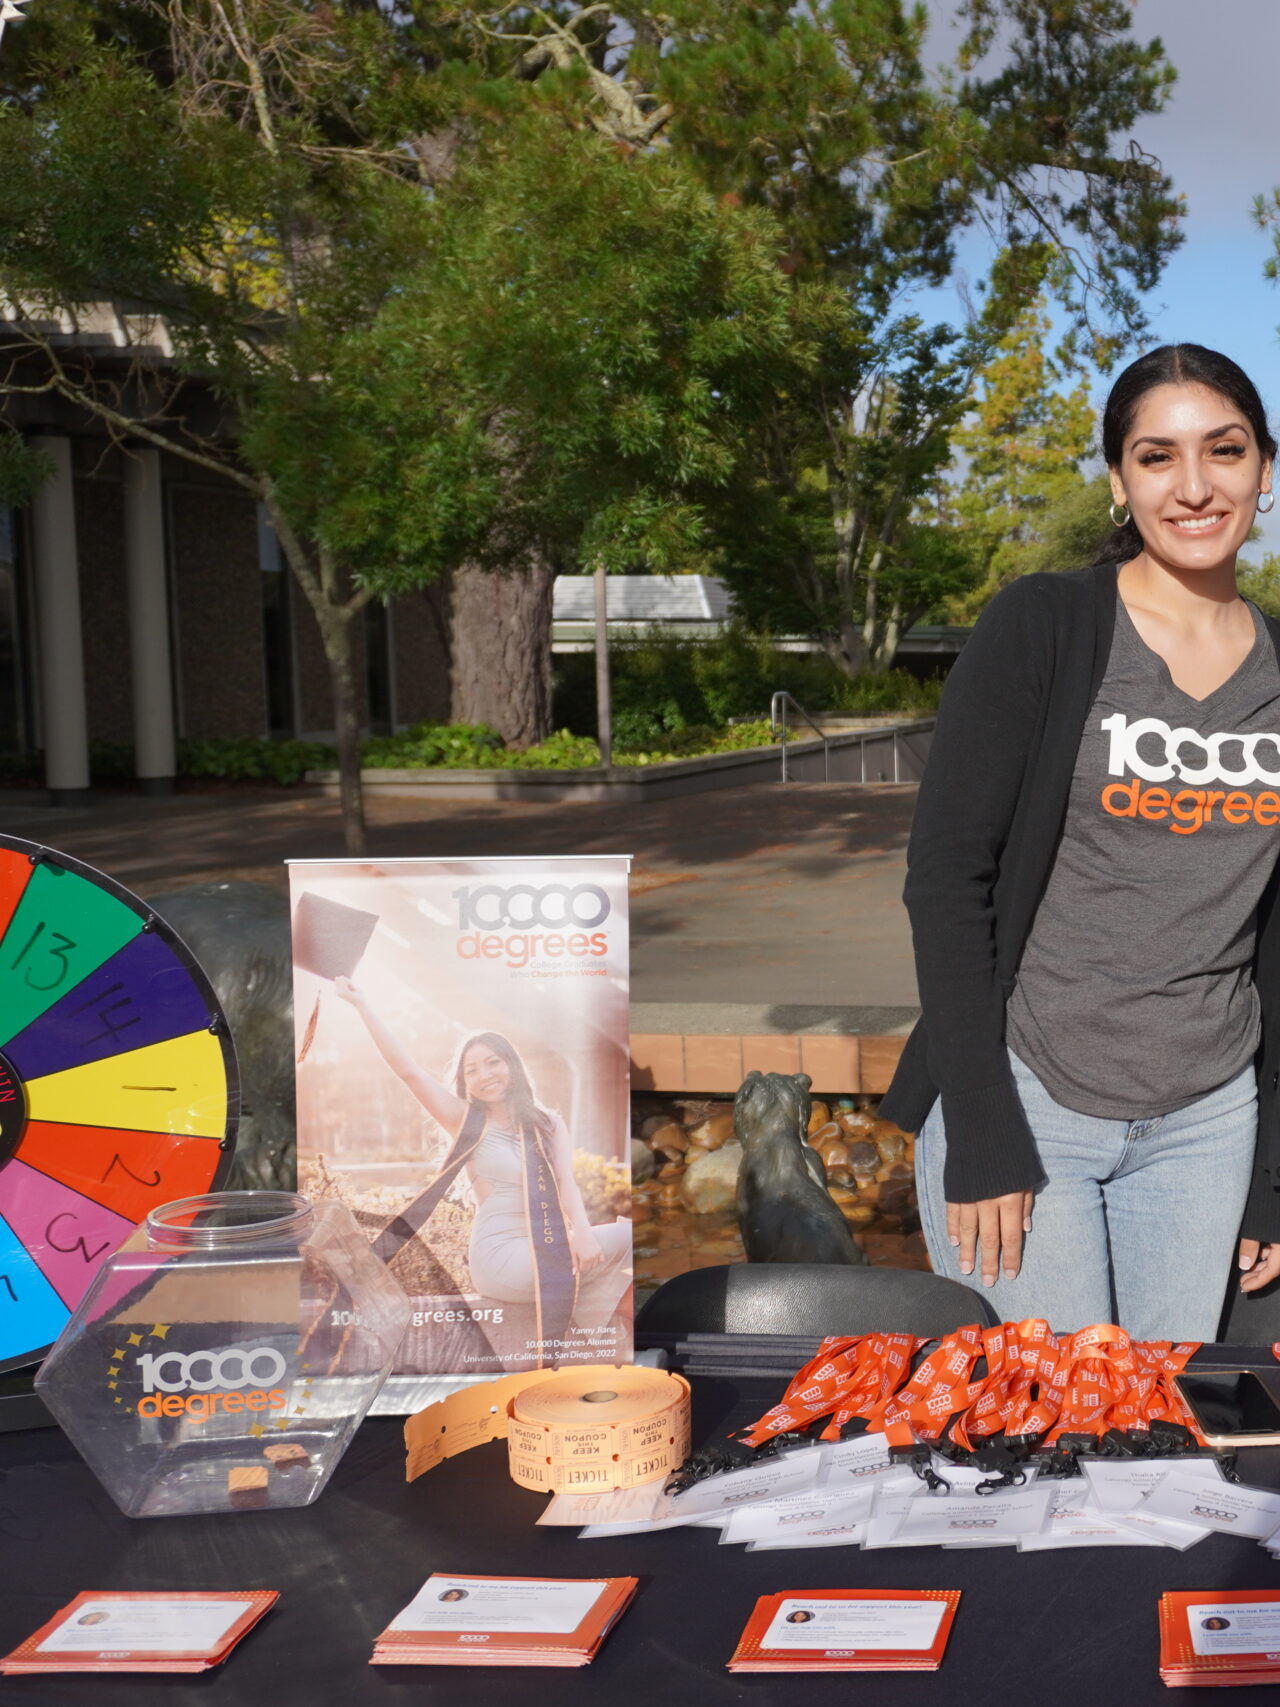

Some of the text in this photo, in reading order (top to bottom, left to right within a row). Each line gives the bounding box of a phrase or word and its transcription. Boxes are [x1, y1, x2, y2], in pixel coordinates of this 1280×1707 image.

[10, 921, 77, 991] 13
[456, 931, 609, 969] degrees
[531, 970, 563, 980] Change
[564, 968, 579, 977] the
[580, 967, 608, 977] World
[570, 1326, 595, 1337] Yanny
[553, 1339, 586, 1351] Degrees
[586, 1337, 617, 1347] Alumna
[462, 1353, 503, 1365] University
[504, 1352, 513, 1362] of
[554, 1350, 569, 1360] San
[596, 1348, 617, 1358] 2022
[137, 1386, 286, 1425] degrees
[632, 1418, 667, 1436] COUPON
[564, 1432, 607, 1443] COUPON
[641, 1433, 663, 1447] KEEP
[572, 1446, 601, 1456] KEEP
[518, 1463, 544, 1482] TICKET
[637, 1454, 669, 1476] TICKET
[568, 1469, 608, 1484] TICKET
